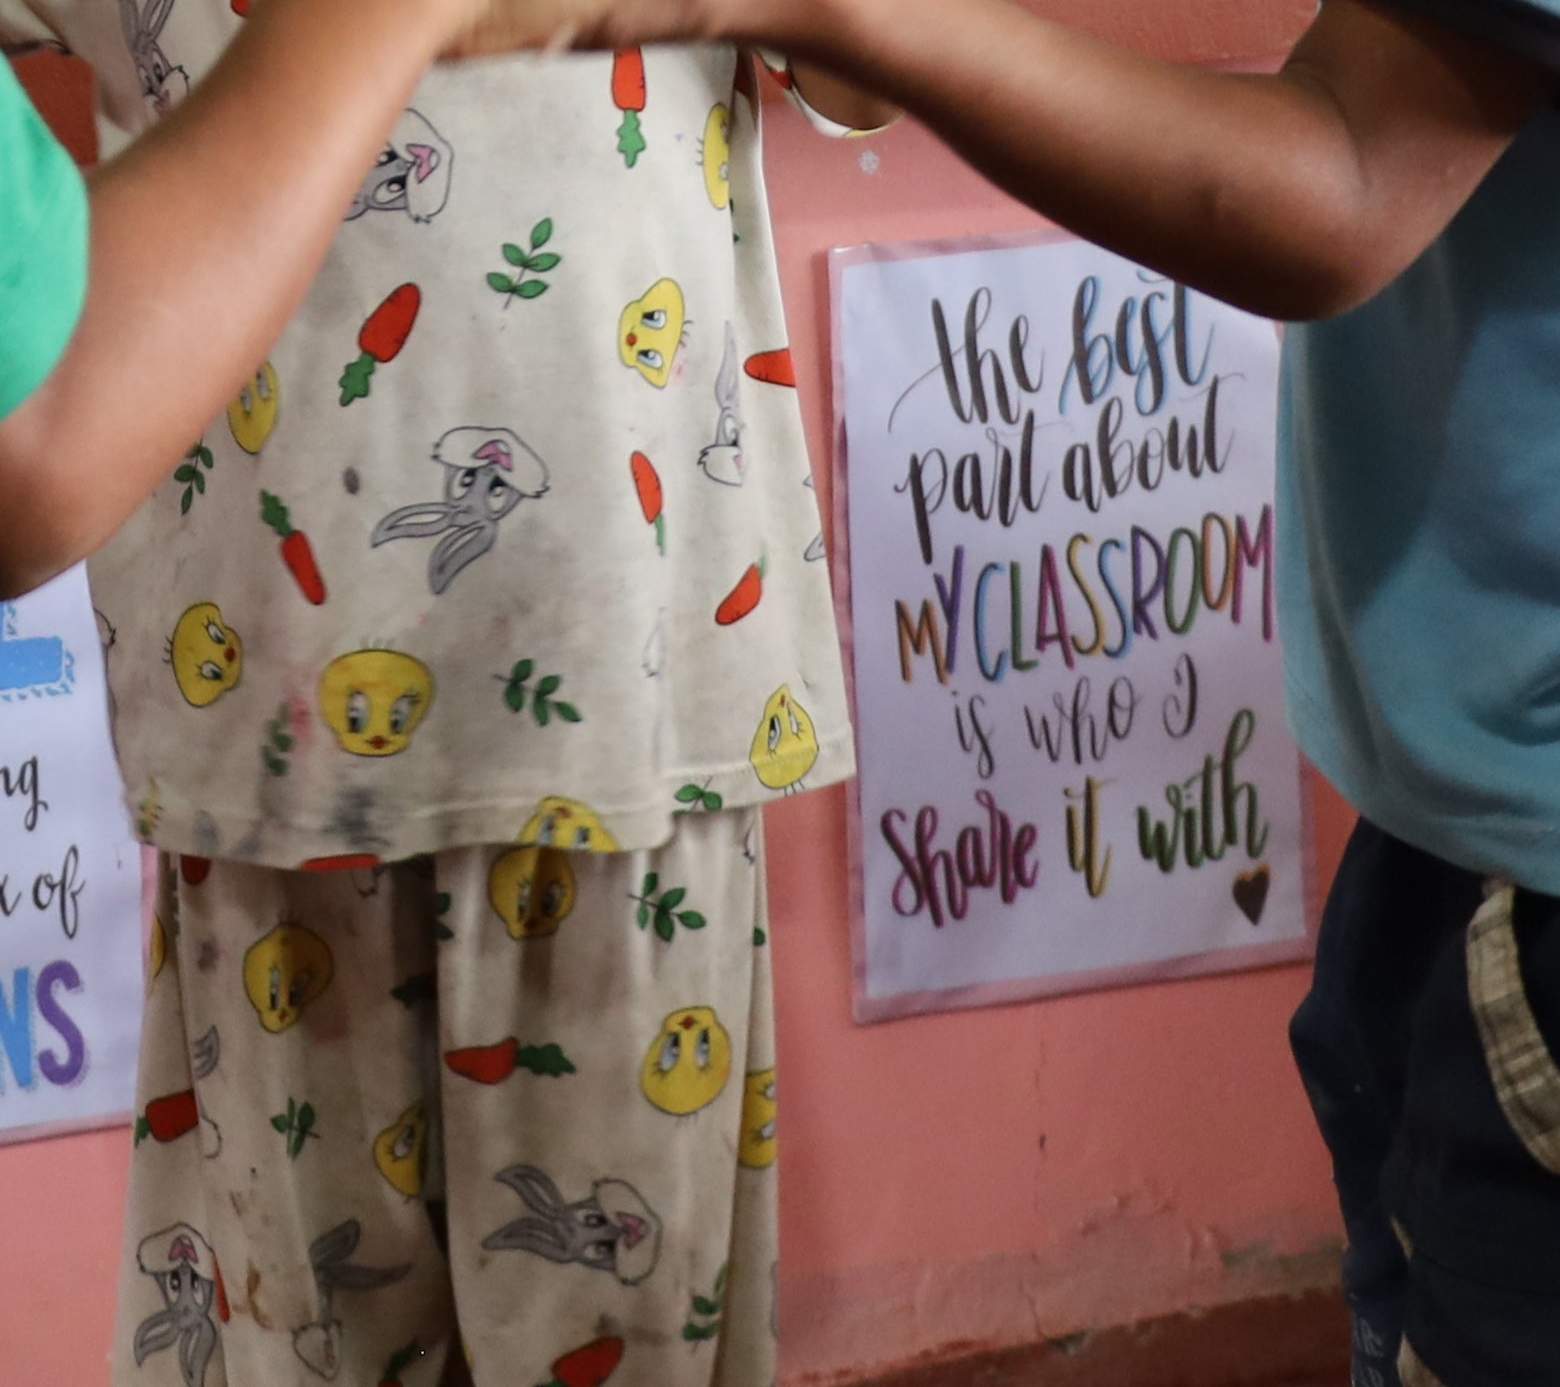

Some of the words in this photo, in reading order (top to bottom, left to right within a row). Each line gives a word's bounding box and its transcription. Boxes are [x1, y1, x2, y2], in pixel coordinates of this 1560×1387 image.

[889, 286, 1043, 432] the
[1059, 273, 1215, 417] best
[894, 410, 1050, 565] part
[1061, 372, 1245, 514] about
[951, 690, 996, 779] is
[1023, 673, 1135, 766] who
[1065, 776, 1116, 898] it
[1136, 706, 1269, 875] with
[30, 842, 88, 940] of
